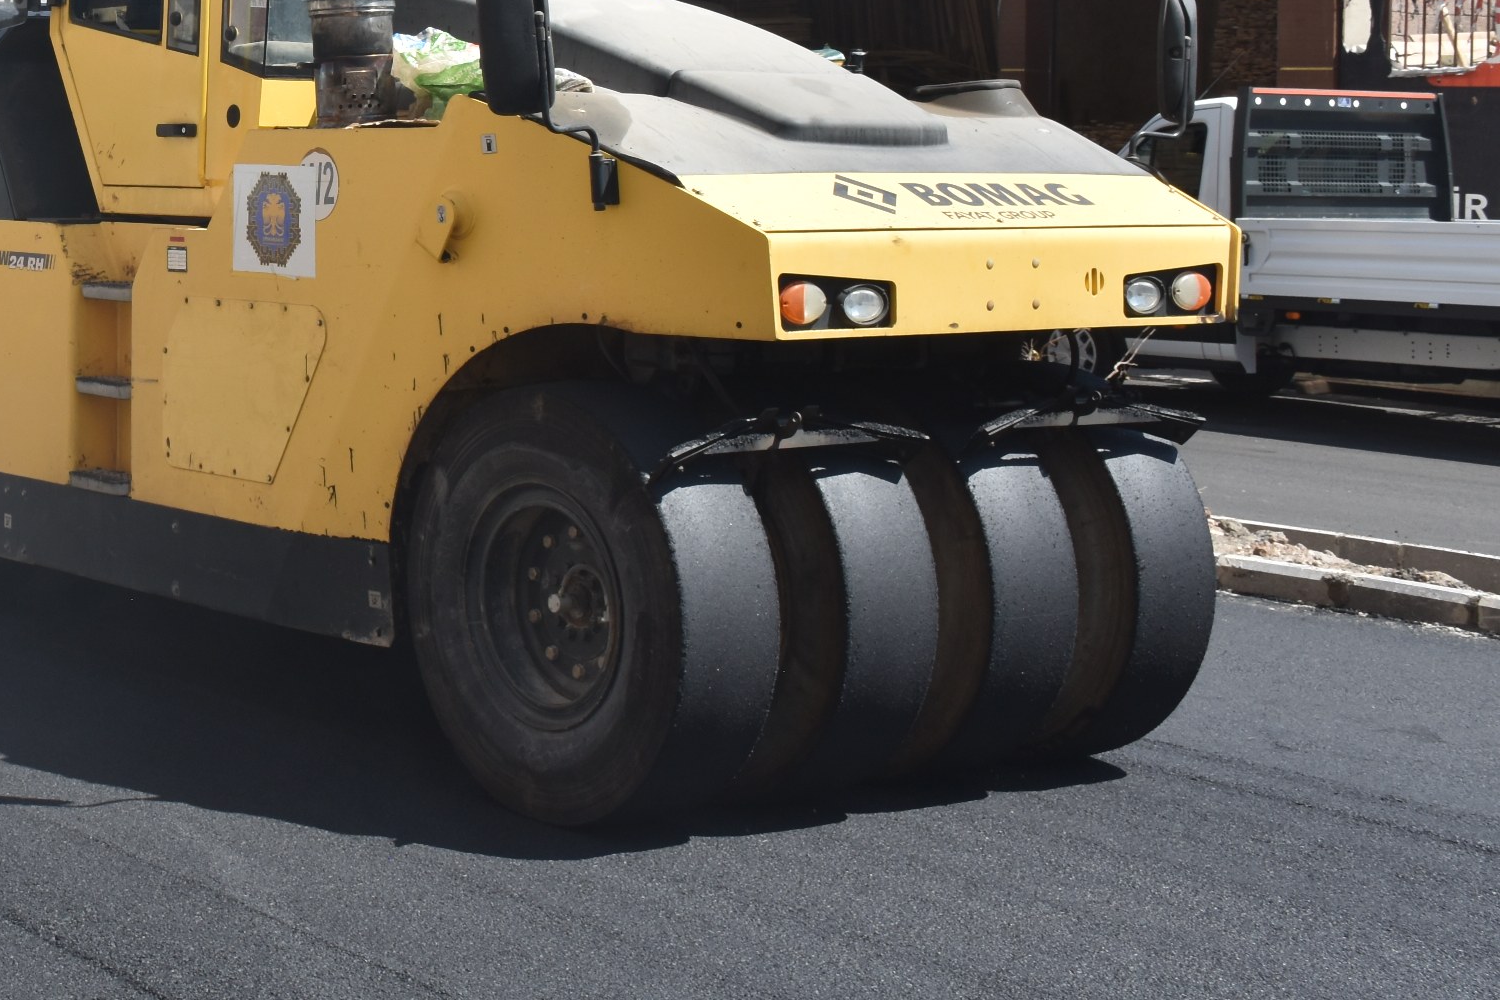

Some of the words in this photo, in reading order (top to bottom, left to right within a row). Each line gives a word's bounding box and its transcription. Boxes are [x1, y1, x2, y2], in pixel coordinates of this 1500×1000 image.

[898, 182, 1096, 206] BOMAG
[942, 211, 996, 220] FAYAT
[998, 210, 1056, 219] GROUP
[27, 256, 45, 271] RH
